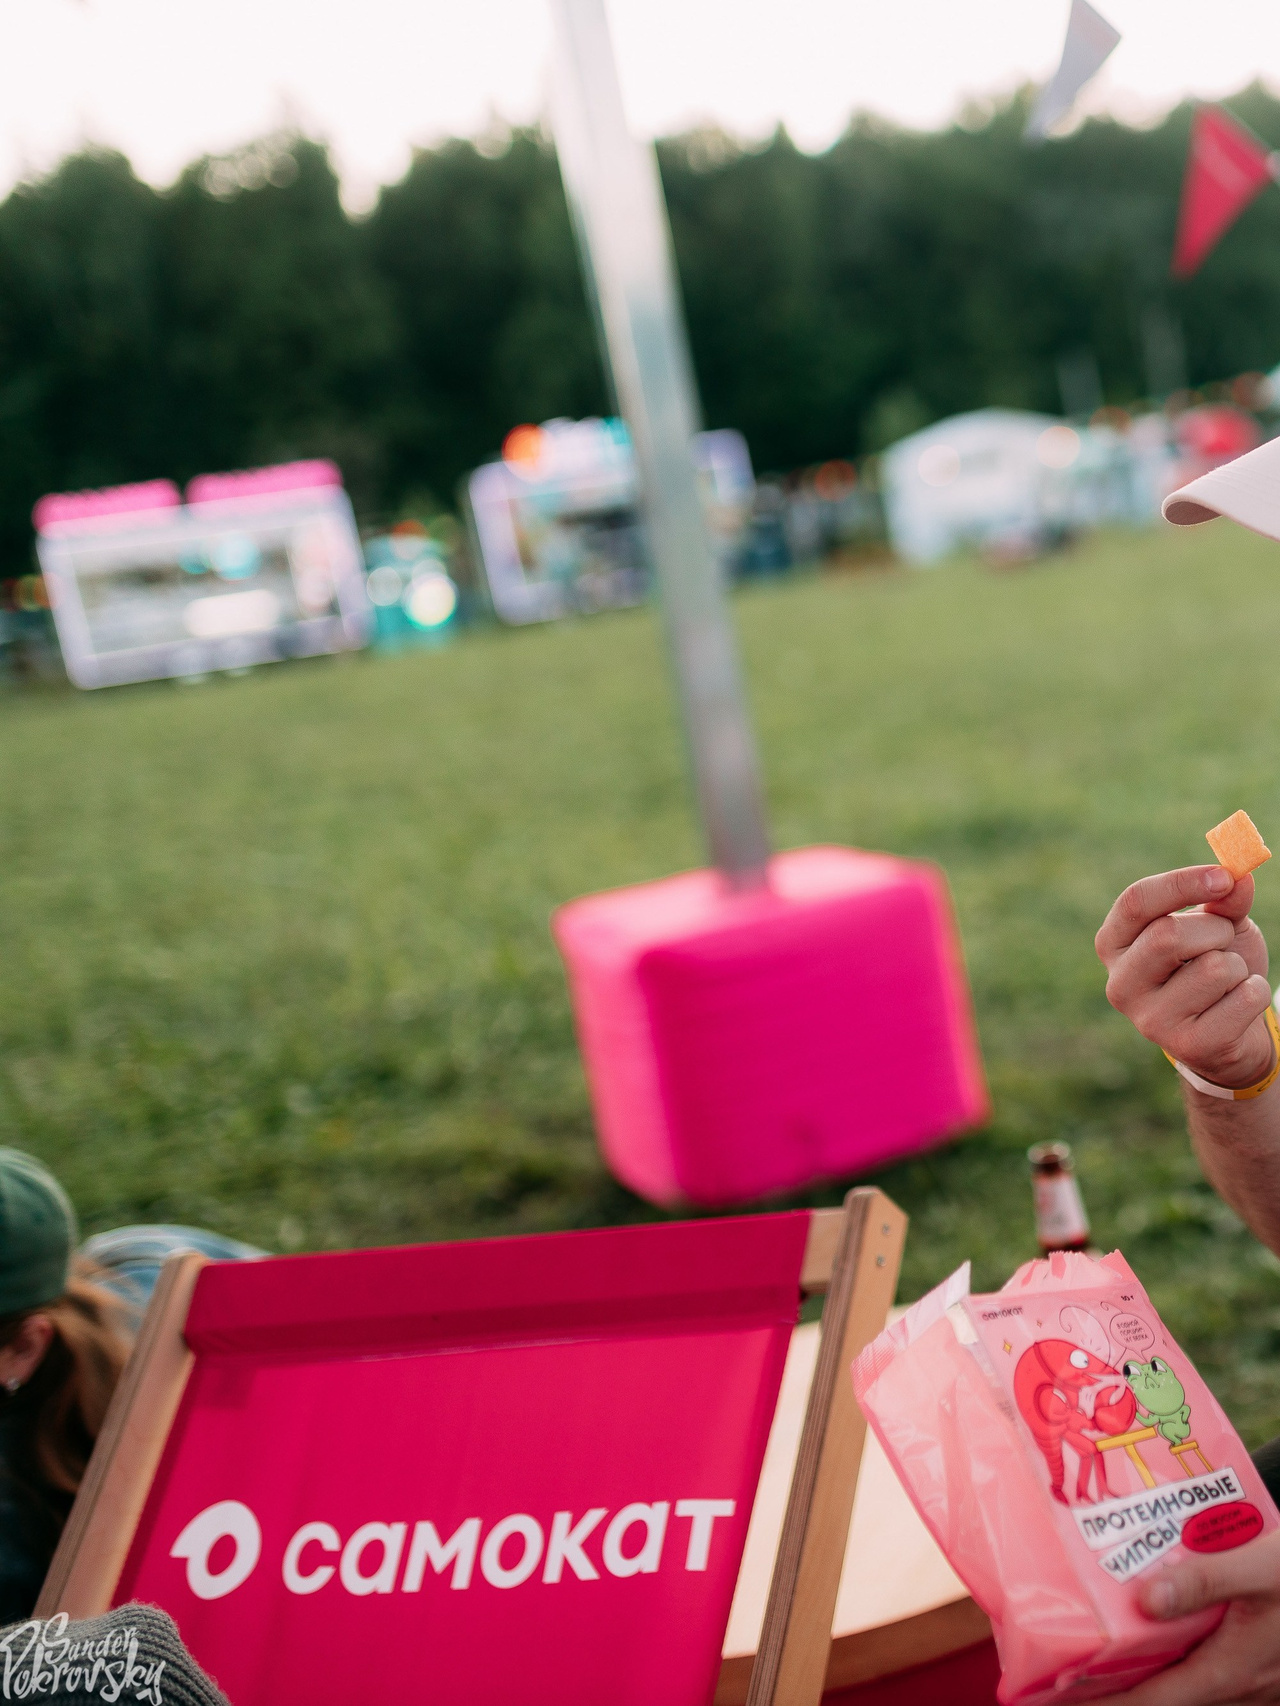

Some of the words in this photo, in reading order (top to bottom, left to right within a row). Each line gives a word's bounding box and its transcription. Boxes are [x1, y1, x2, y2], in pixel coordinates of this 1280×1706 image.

[1082, 1475, 1238, 1538] ПРОТЕИНОВЫЕ
[282, 1498, 736, 1596] самокат
[1104, 1519, 1180, 1574] ЧИПСЫ
